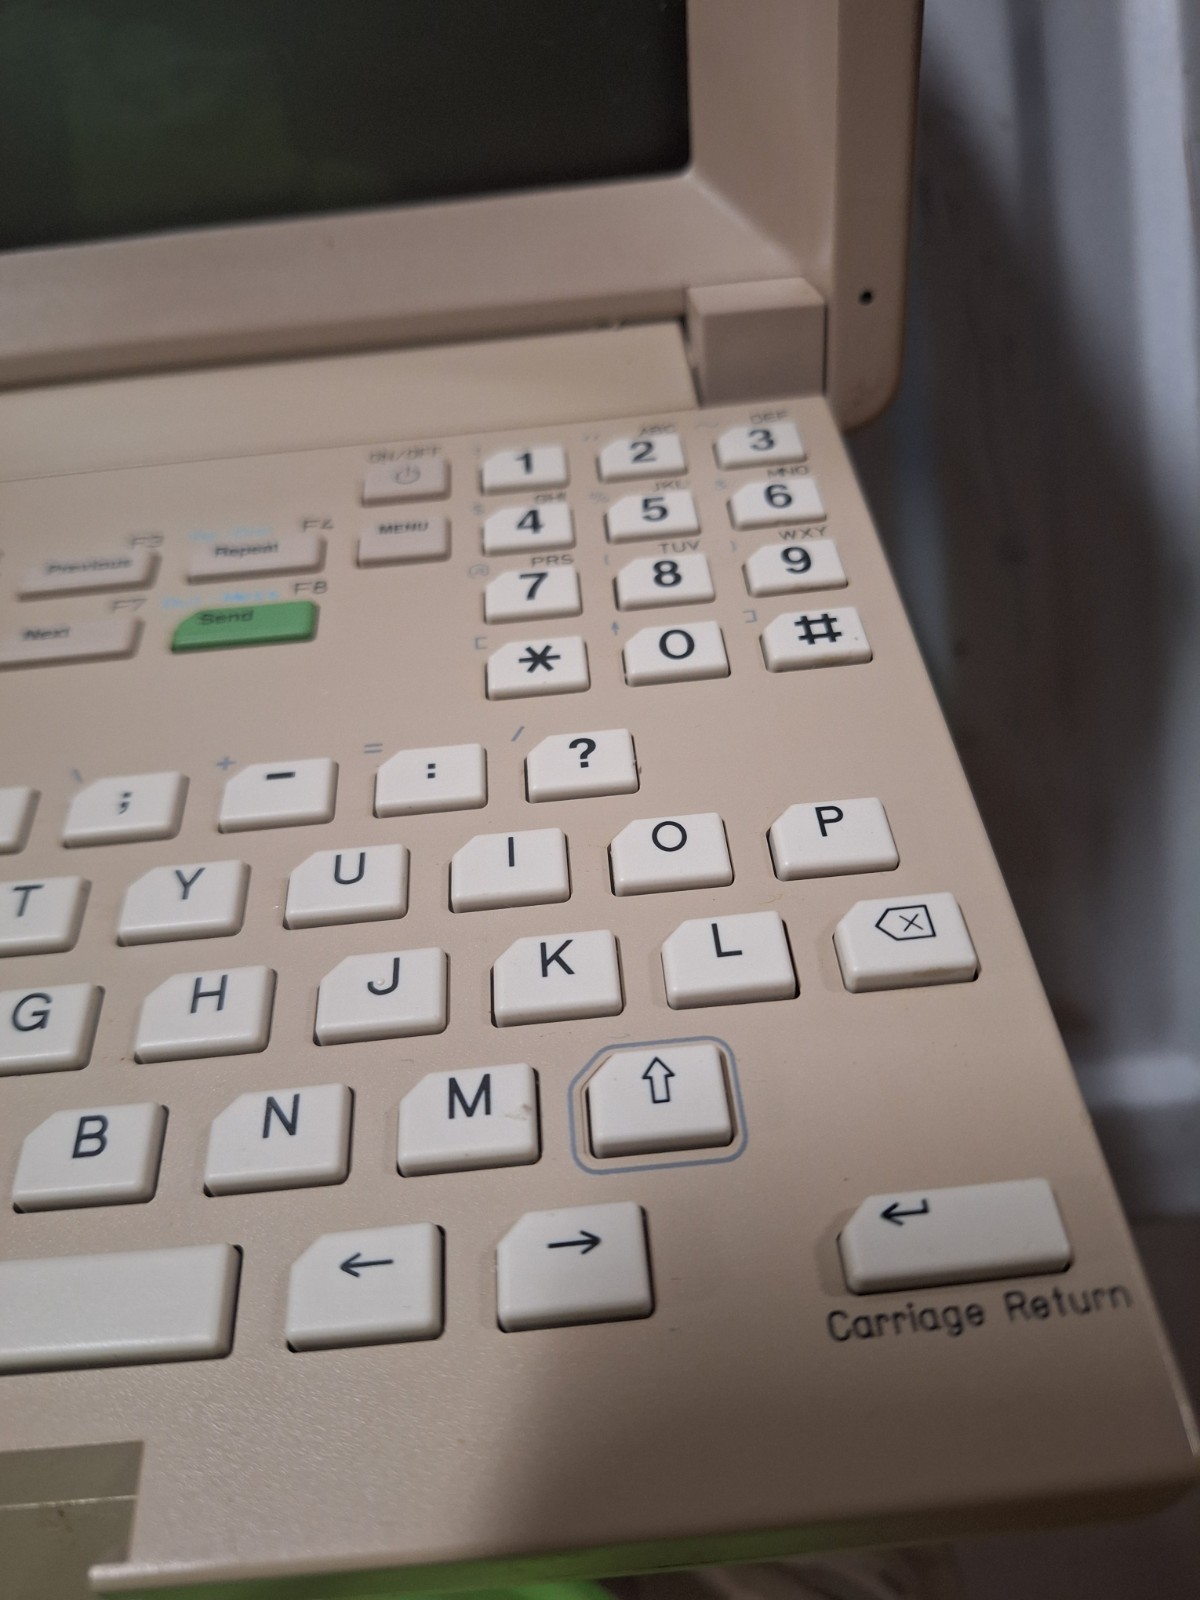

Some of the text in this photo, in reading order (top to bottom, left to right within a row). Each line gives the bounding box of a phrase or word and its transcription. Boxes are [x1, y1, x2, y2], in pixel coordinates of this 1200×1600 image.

[630, 441, 658, 464] 2
[748, 428, 775, 451] 3
[516, 453, 533, 474] 1
[642, 497, 669, 522] 5
[764, 484, 793, 509] 6
[378, 522, 429, 535] MENU
[516, 509, 545, 534] 4
[778, 527, 827, 540] WXY
[531, 554, 574, 567] PRS
[659, 541, 700, 554] TUV
[781, 546, 812, 574] 9
[294, 581, 328, 595] F8
[519, 572, 548, 600] 7
[653, 560, 682, 587] 8
[200, 610, 254, 626] Send
[794, 613, 842, 645] #
[568, 737, 597, 769] ?
[427, 763, 437, 779] :
[651, 820, 688, 853] O
[814, 805, 844, 837] P
[507, 836, 516, 868] I
[175, 867, 206, 900] Y
[333, 852, 366, 885] U
[13, 884, 45, 917] T
[711, 922, 743, 958] L
[540, 939, 577, 978] K
[367, 957, 401, 996] J
[190, 974, 228, 1014] H
[11, 992, 52, 1032] G
[447, 1073, 492, 1119] M
[262, 1094, 300, 1139] N
[71, 1114, 109, 1159] B
[826, 1284, 1135, 1343] Carriage Return
